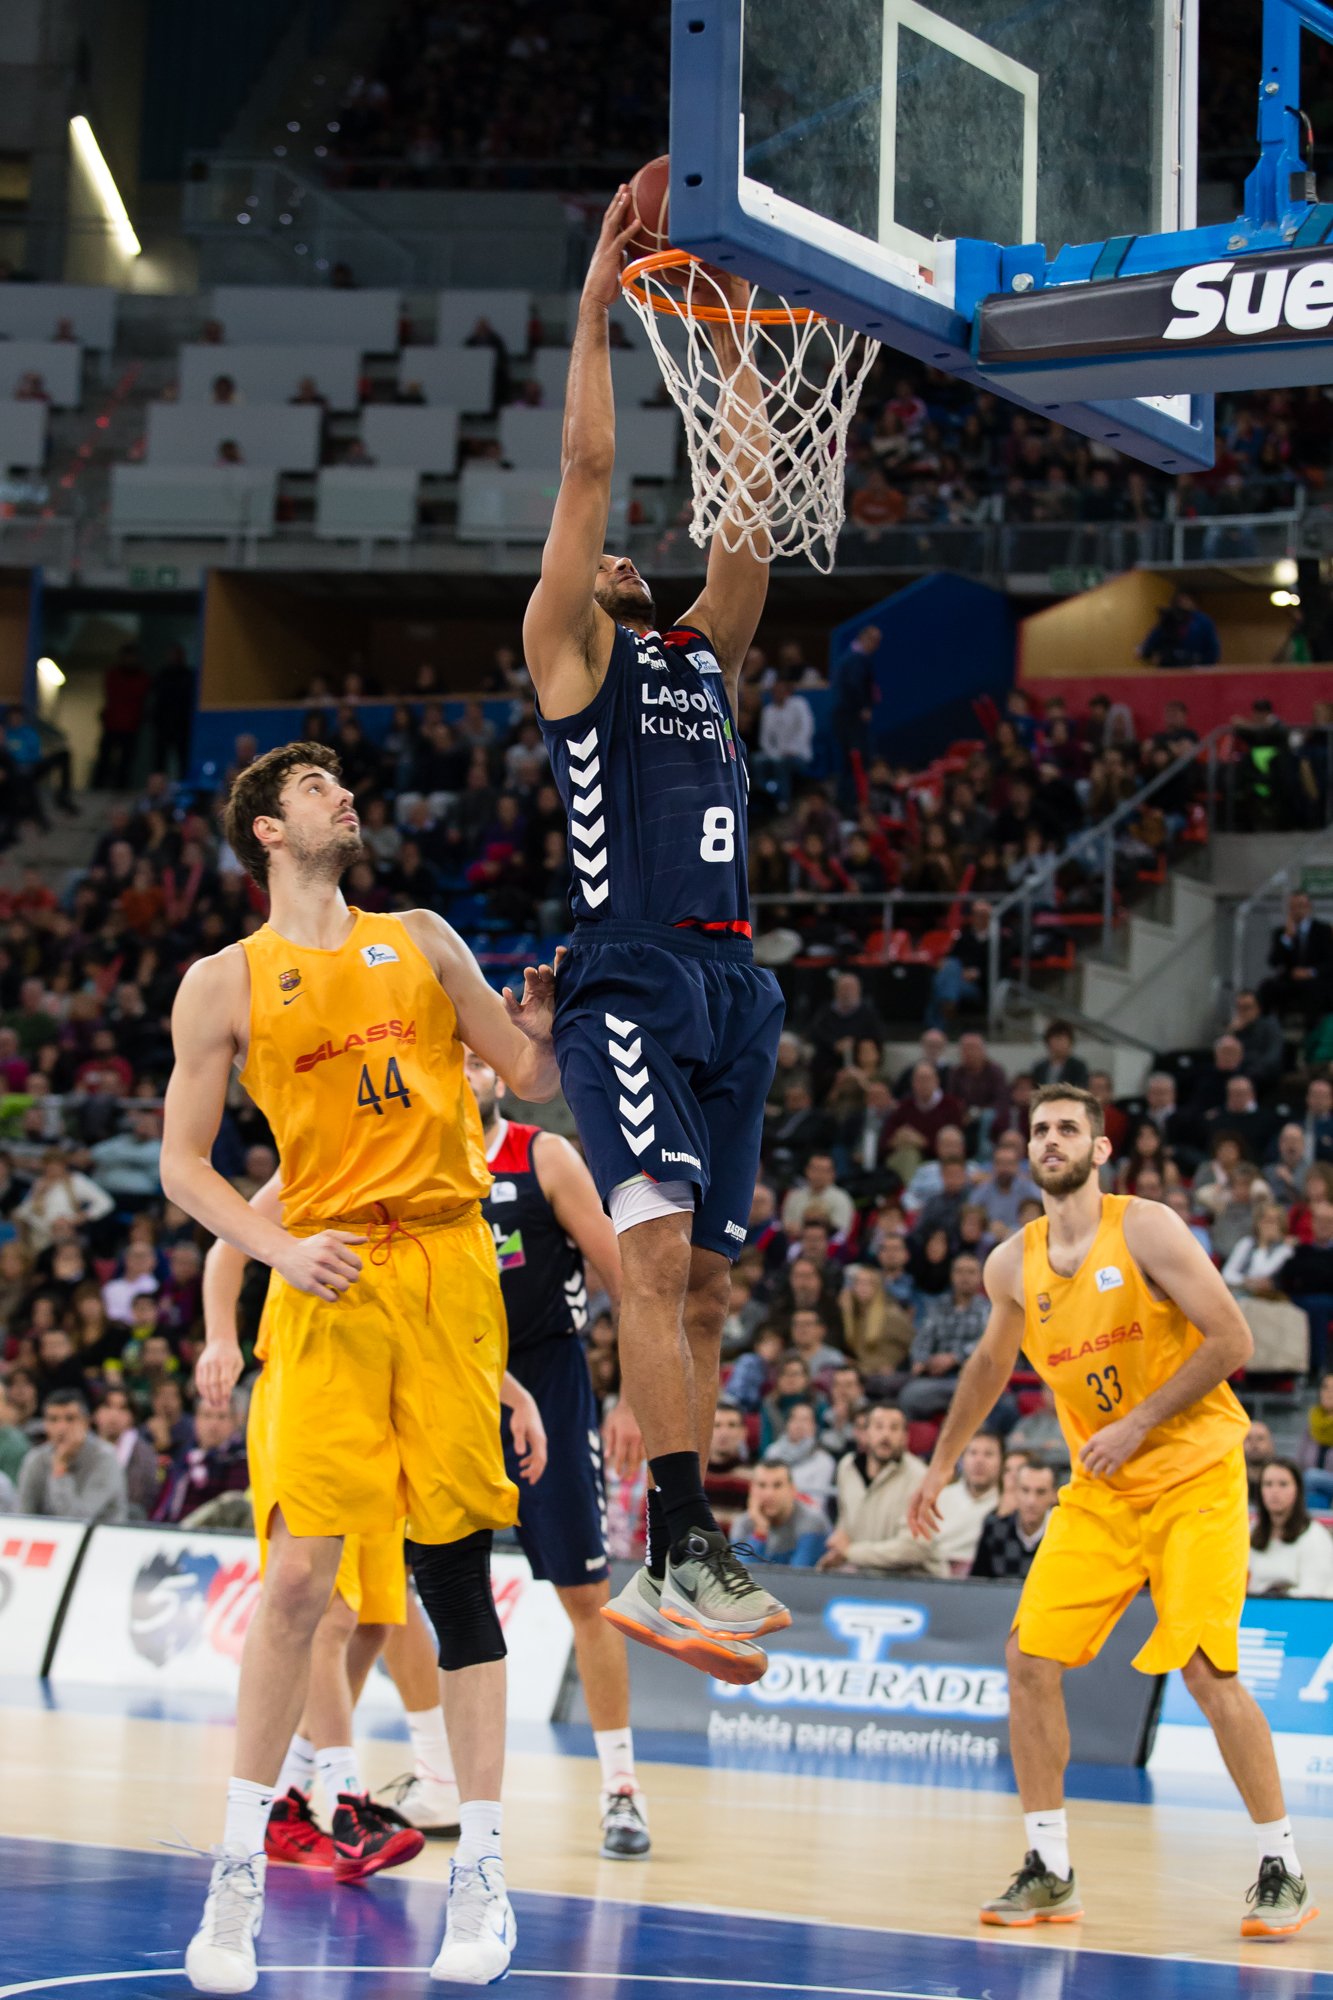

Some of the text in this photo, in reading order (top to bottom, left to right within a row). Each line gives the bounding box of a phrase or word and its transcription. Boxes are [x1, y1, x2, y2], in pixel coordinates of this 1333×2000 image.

[700, 806, 735, 863] 8
[327, 1019, 416, 1059] LASSA
[357, 1056, 411, 1115] 44
[1065, 1321, 1144, 1362] LASSA
[1086, 1364, 1122, 1412] 33
[714, 1654, 1009, 1715] OWERADE
[708, 1710, 1000, 1759] bebida para deportistas
